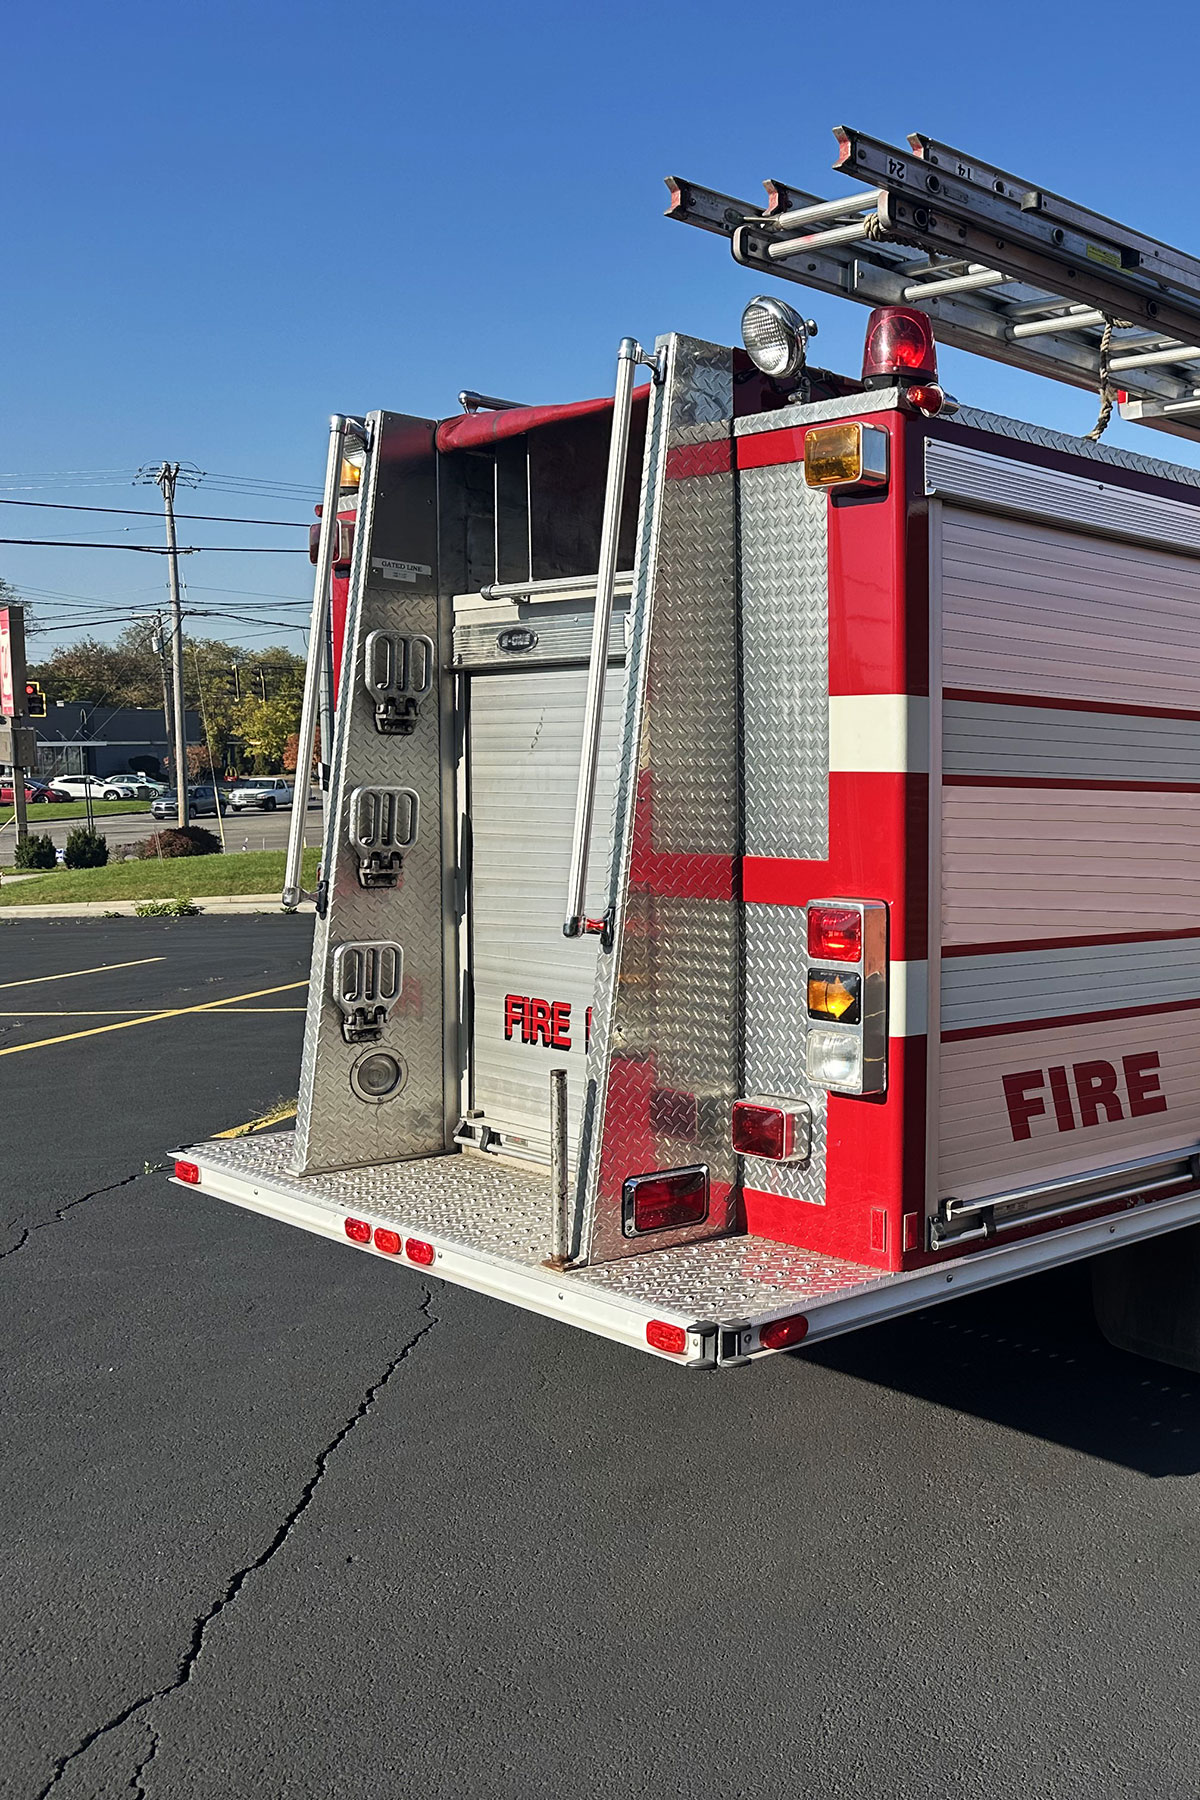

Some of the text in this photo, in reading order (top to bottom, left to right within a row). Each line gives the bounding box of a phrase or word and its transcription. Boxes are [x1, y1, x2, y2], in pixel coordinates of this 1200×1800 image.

[888, 158, 905, 180] 24
[957, 163, 974, 181] 14
[381, 560, 423, 573] GATED LINE
[504, 994, 572, 1051] FIRE
[1002, 1051, 1168, 1141] FIRE
